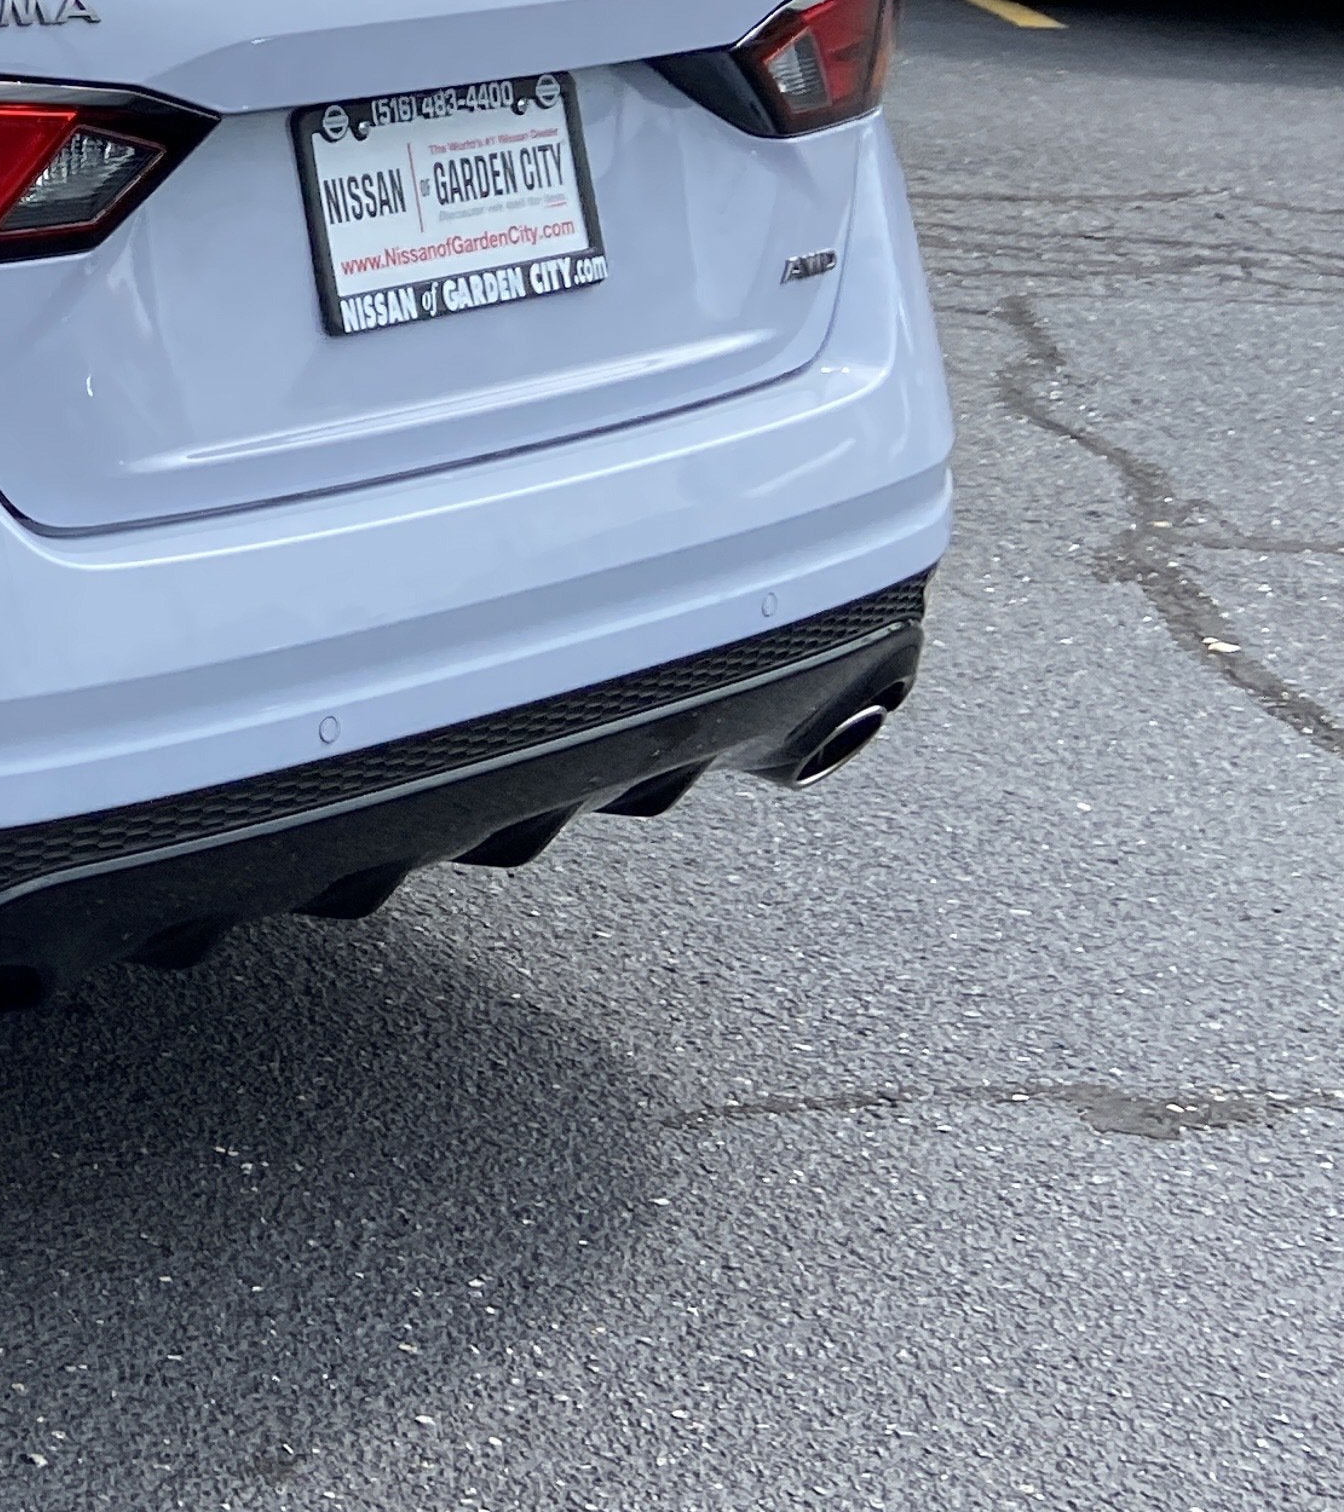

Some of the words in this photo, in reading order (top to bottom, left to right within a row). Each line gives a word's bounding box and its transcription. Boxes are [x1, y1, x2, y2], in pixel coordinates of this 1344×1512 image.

[371, 95, 417, 126] (516)
[421, 80, 513, 119] 483-4400
[323, 169, 407, 224] NISSAN
[433, 150, 518, 206] GARDEN
[519, 142, 564, 190] CITY
[340, 219, 576, 275] www.NissanofGardenCity.com
[340, 287, 419, 333] NISSAN
[422, 281, 439, 317] of
[443, 266, 526, 311] GARDEN
